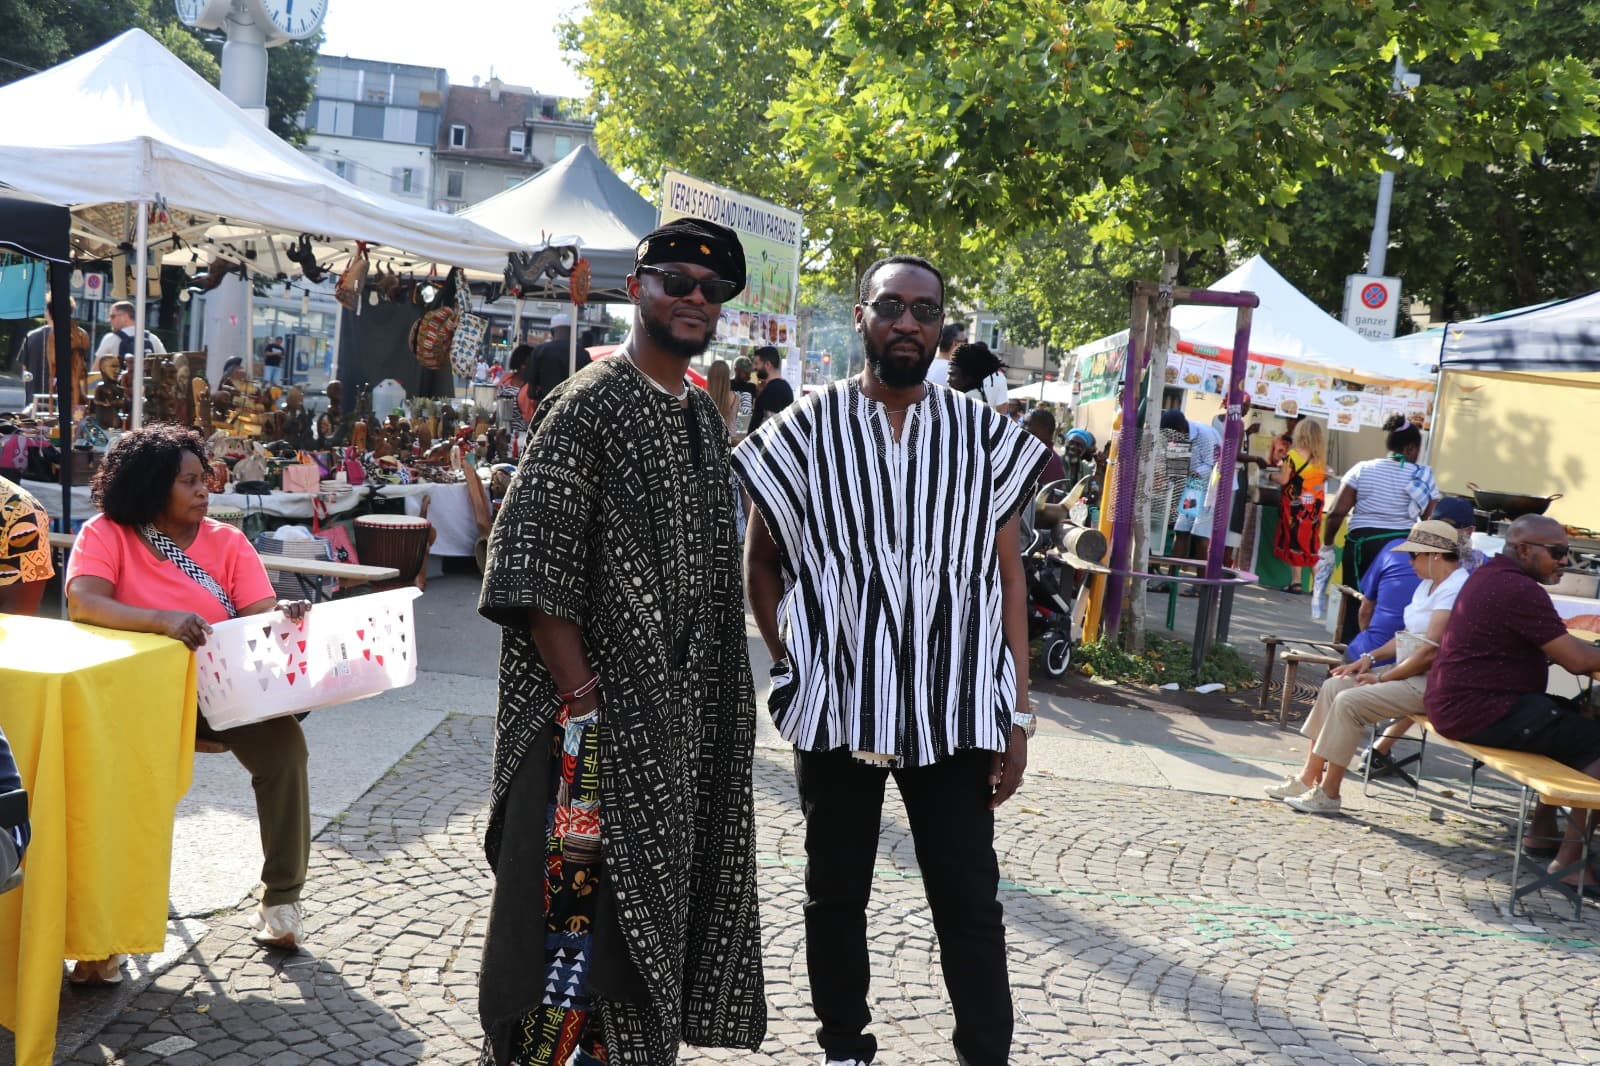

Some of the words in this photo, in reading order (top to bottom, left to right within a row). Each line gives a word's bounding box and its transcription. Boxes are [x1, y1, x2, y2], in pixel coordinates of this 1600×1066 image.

[670, 181, 697, 215] VERA'S
[698, 190, 720, 221] FOOD
[720, 199, 737, 227] AND
[737, 204, 765, 235] VITAMIN
[766, 213, 796, 245] PARADISE
[1355, 316, 1388, 326] ganzer
